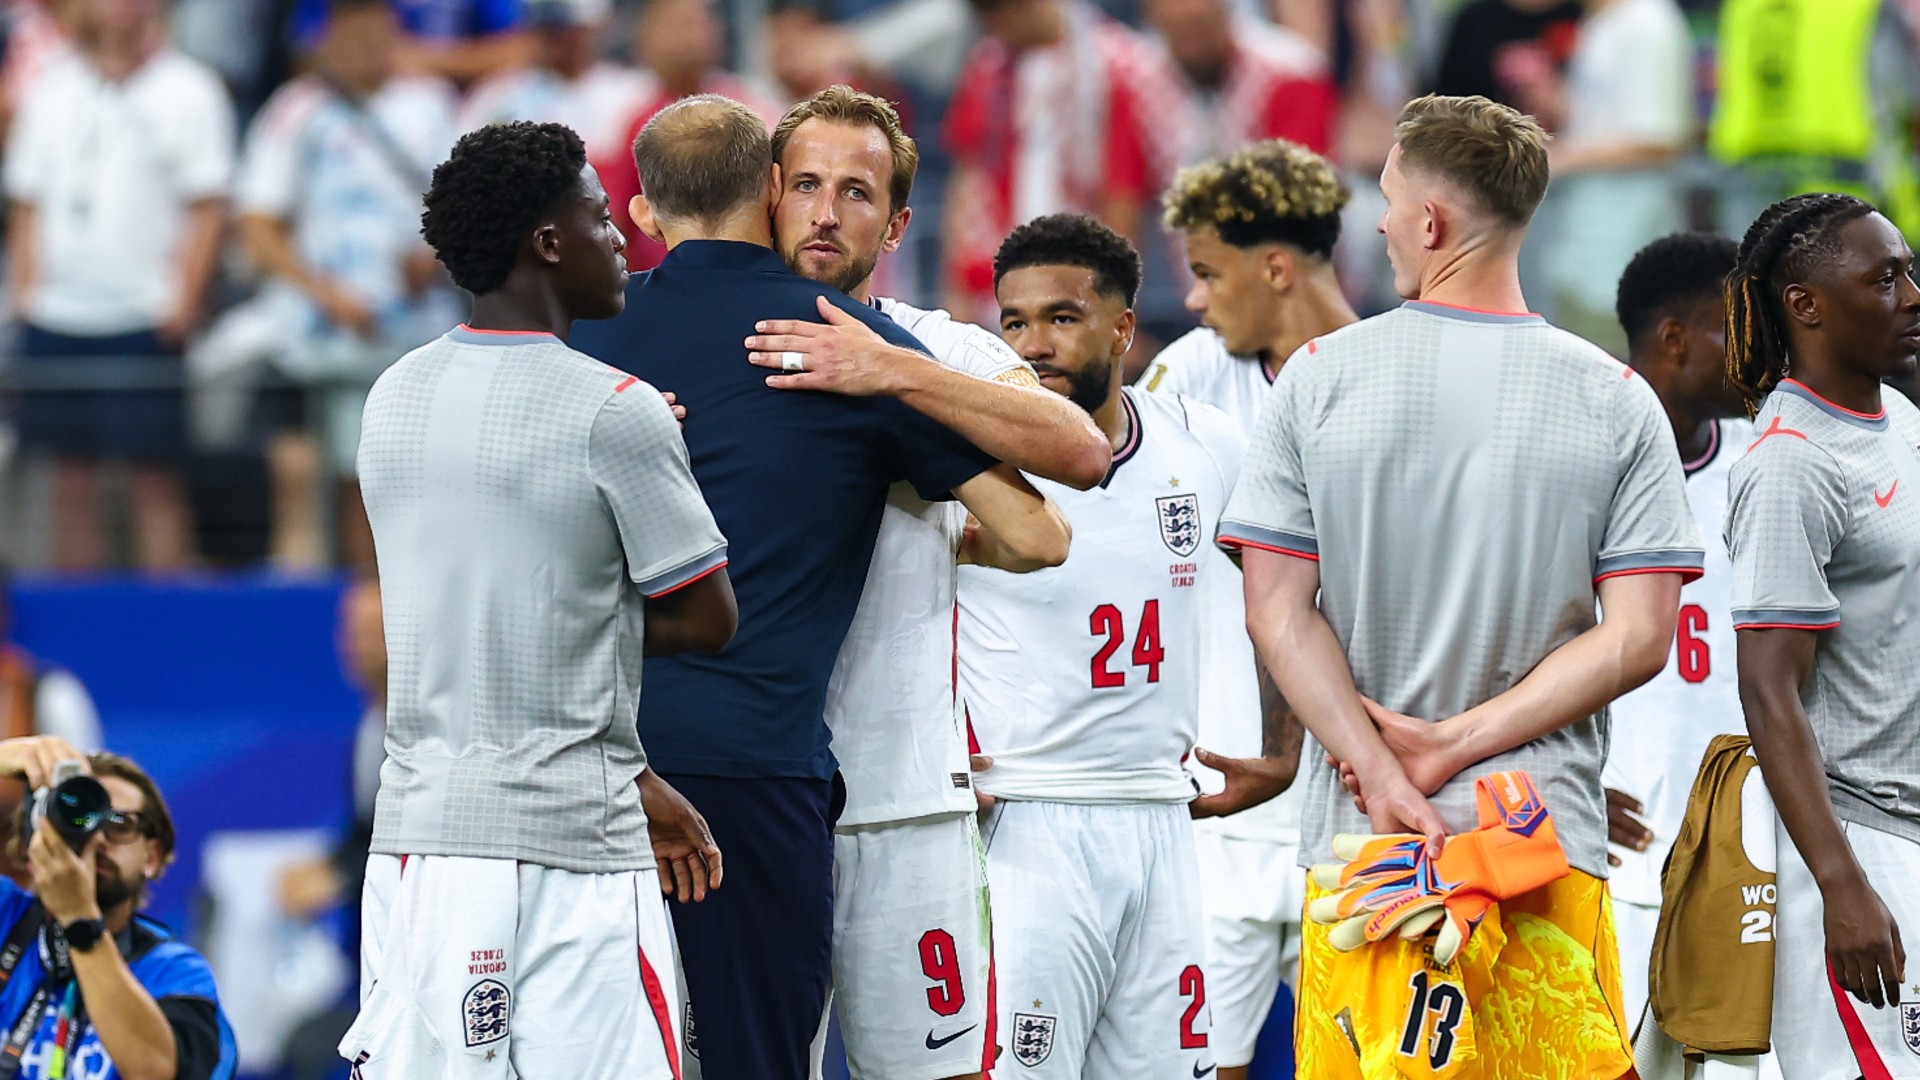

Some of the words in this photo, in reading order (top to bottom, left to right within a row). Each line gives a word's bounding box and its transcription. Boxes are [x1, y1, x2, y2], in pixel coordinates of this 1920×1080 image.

[1169, 563, 1197, 575] CROATIA
[1089, 599, 1165, 688] 24
[1677, 604, 1711, 684] 6
[1369, 893, 1421, 933] reusch
[1741, 884, 1777, 906] WO
[1740, 910, 1777, 944] 2
[468, 961, 507, 975] CROATIA
[470, 949, 504, 961] 17.06.26
[918, 928, 965, 1017] 9
[1179, 964, 1213, 1050] 2
[1399, 969, 1467, 1072] 13
